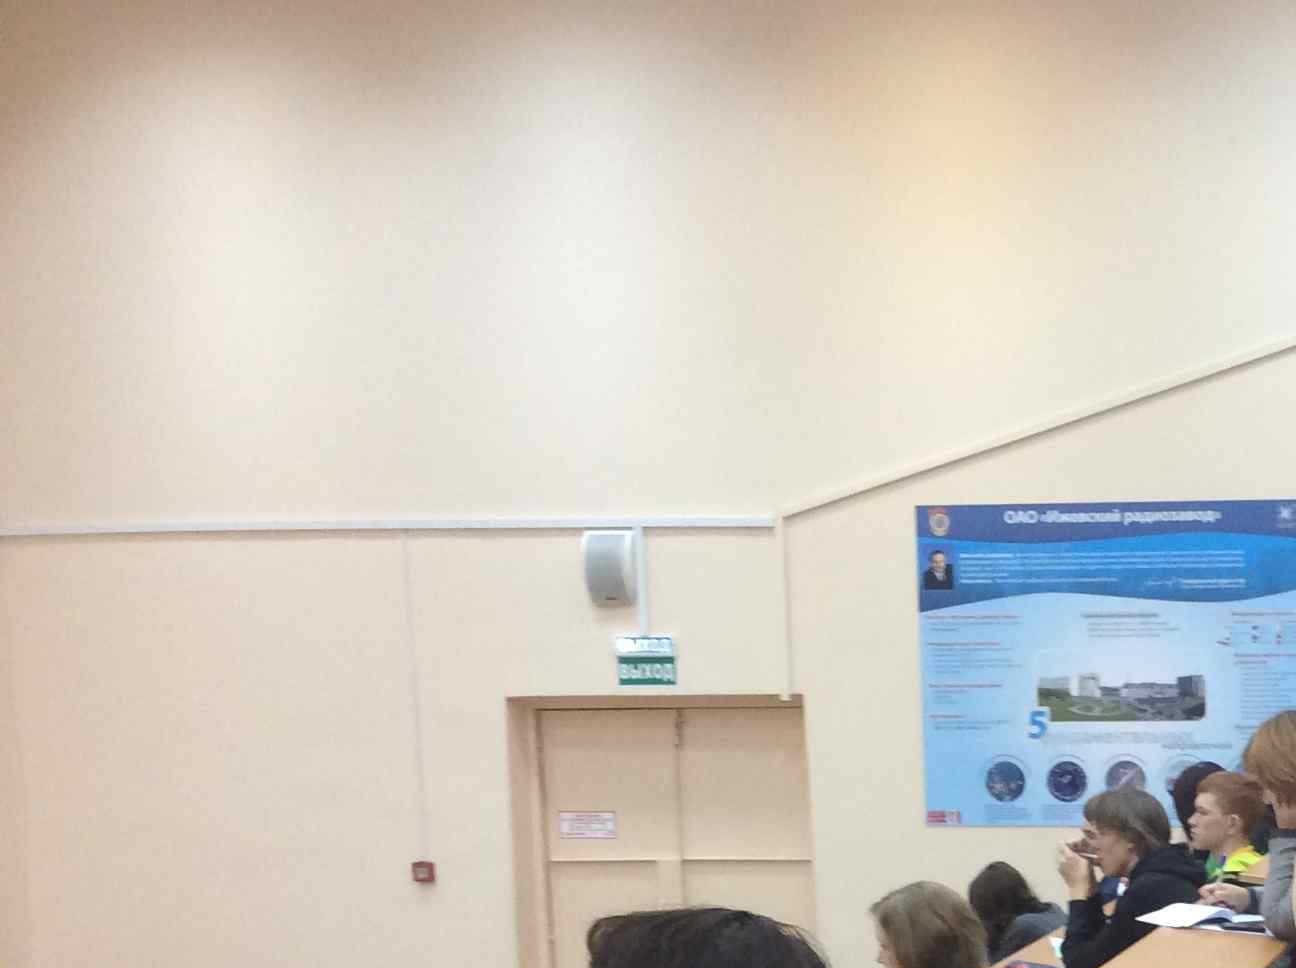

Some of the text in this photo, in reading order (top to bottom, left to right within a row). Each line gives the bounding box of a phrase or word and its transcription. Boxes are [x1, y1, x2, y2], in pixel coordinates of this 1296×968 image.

[1003, 510, 1039, 524] ОАО
[619, 663, 675, 682] ВЫХОД
[1028, 710, 1048, 739] 5
